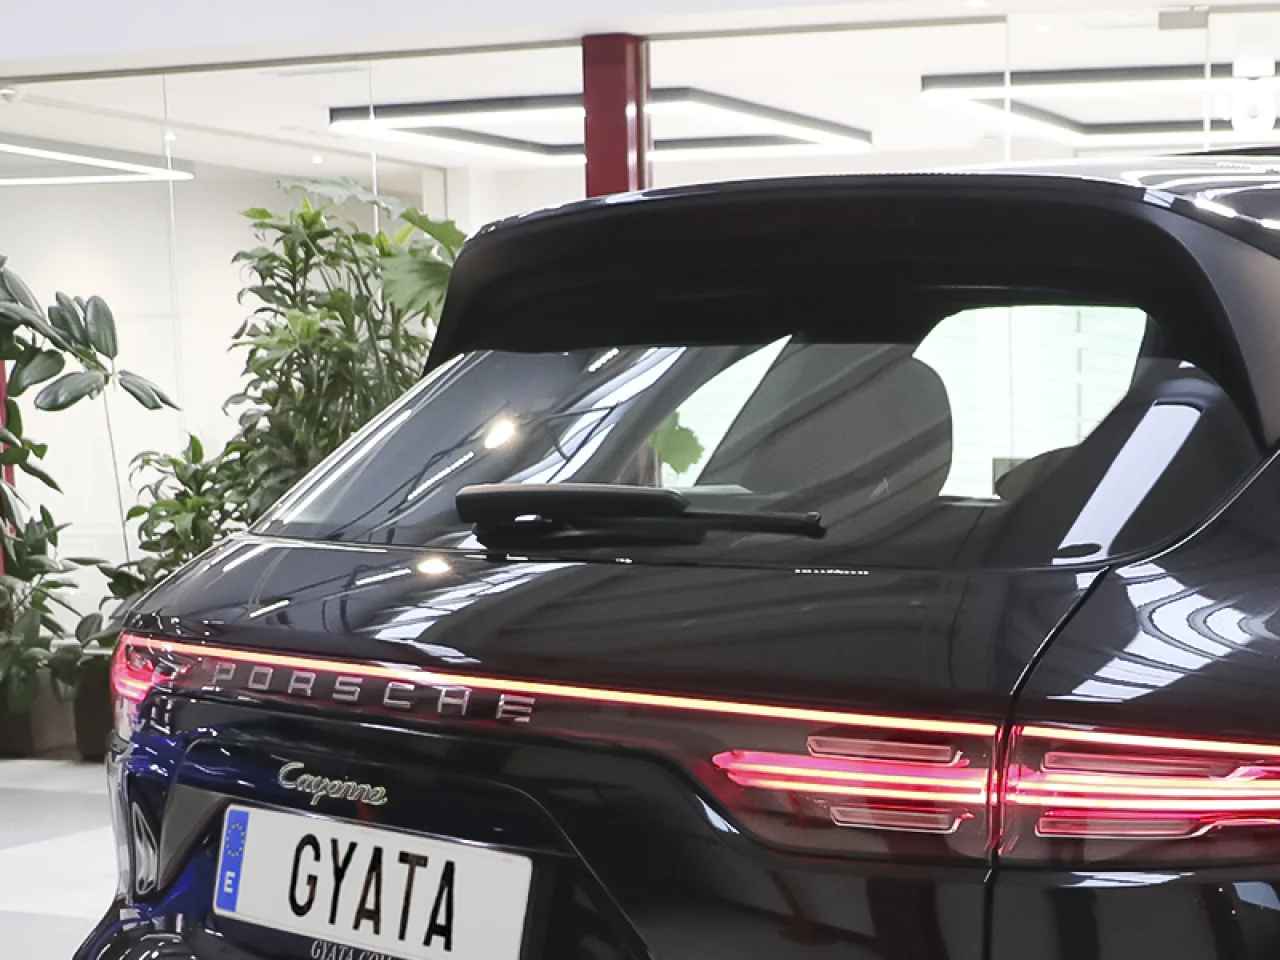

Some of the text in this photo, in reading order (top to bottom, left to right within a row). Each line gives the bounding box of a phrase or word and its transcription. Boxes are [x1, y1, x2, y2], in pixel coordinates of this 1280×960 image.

[212, 662, 536, 723] PORSCHE
[279, 762, 388, 806] Cayenne
[223, 871, 236, 894] E
[288, 833, 456, 952] GYATA
